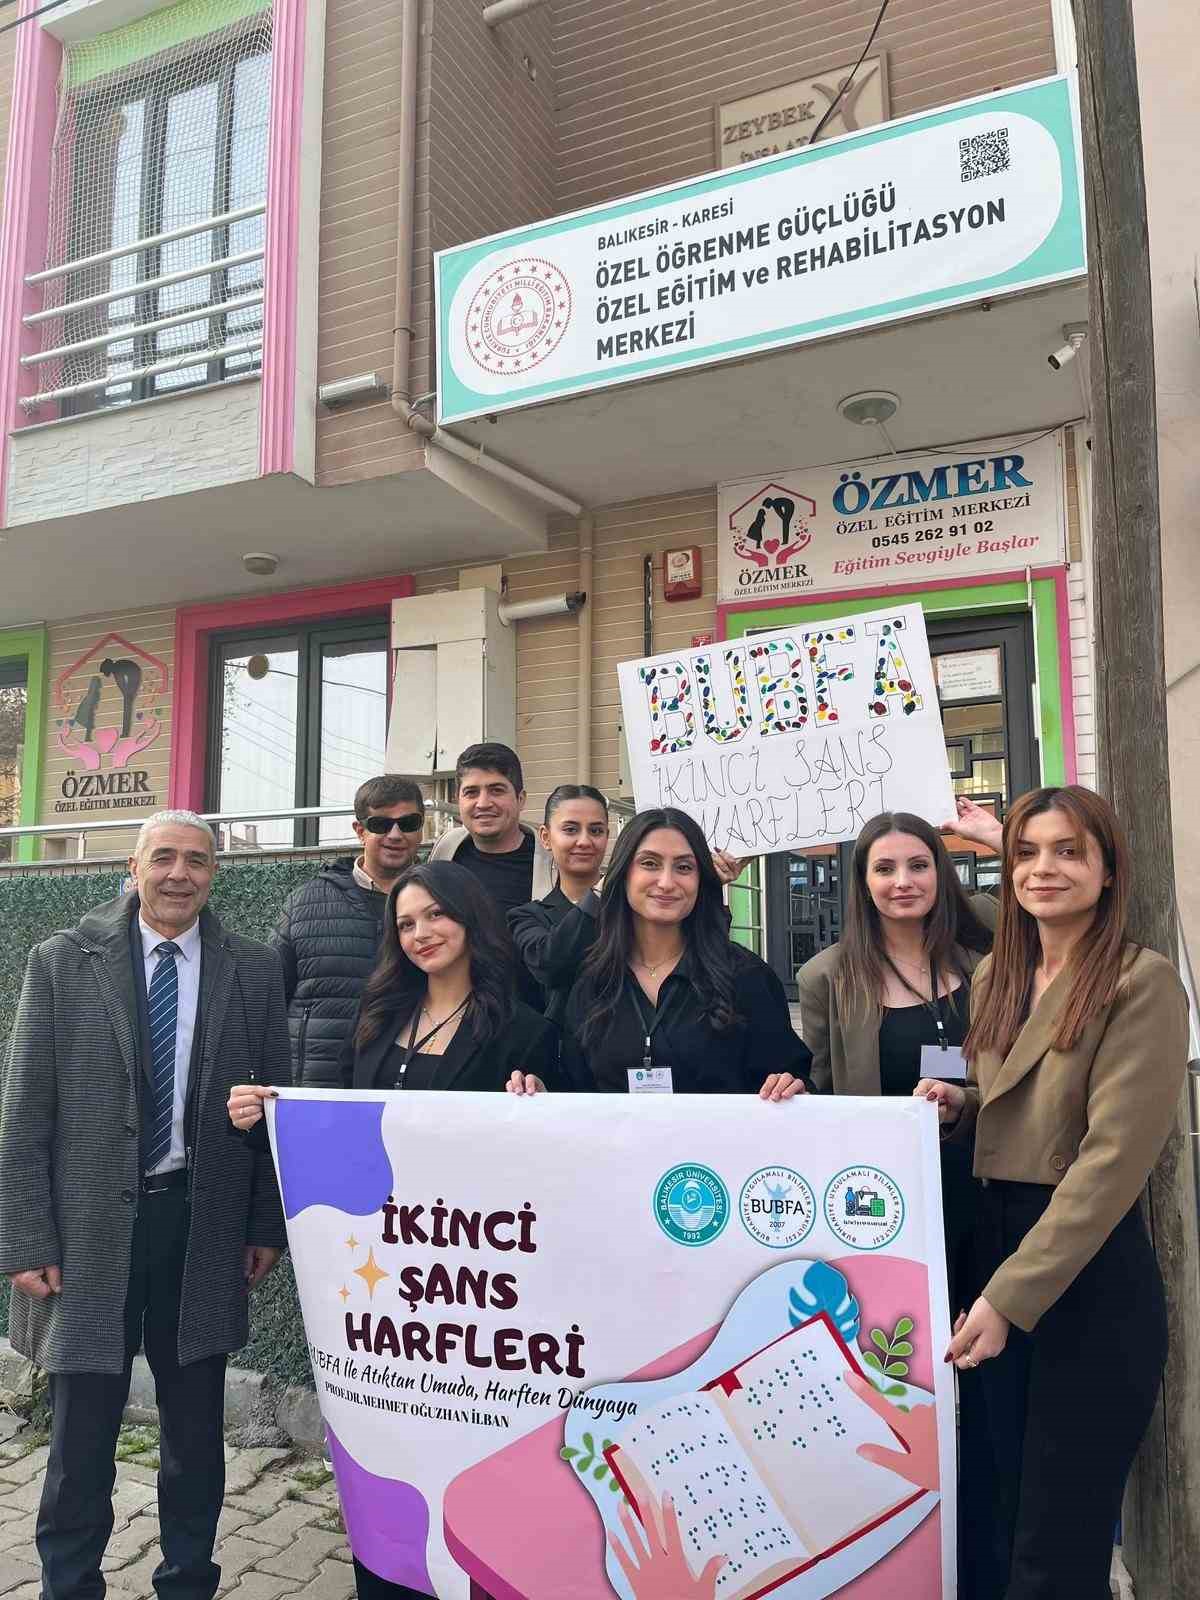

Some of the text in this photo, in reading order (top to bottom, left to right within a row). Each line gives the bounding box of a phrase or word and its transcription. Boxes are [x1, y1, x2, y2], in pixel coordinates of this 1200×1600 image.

[723, 100, 816, 145] ZEYBEK
[596, 181, 896, 288] ÖZEL ÖĞRENME GÜÇLÜĞÜ
[598, 218, 669, 250] BALIKESİR
[682, 197, 734, 228] KARESİ
[596, 198, 1006, 324] ÖZEL EĞİTİM ve REHABİLİTASYON
[597, 310, 695, 361] MERKEZİ
[832, 454, 1033, 516] ÖZMER
[836, 492, 1031, 536] ÖZEL EĞİTİM MERKEZİ
[872, 520, 994, 549] 0545 262 91 02
[738, 563, 809, 587] ÖZMER
[832, 535, 1039, 577] Eğitim Sevgiyle Başlar
[638, 615, 924, 756] BUBFA
[62, 770, 151, 799] ÖZMER
[381, 1195, 537, 1253] İKİNCİ
[750, 1199, 805, 1215] BUBFA
[769, 1220, 786, 1228] 2007
[398, 1263, 519, 1313] ŞANS
[345, 1312, 586, 1379] HARFLERİ
[344, 1356, 358, 1380] İle
[361, 1364, 416, 1391] Atıktan
[420, 1372, 479, 1401] Umuda,
[484, 1380, 552, 1409] Harften
[557, 1387, 638, 1423] Dünyaya
[410, 1402, 470, 1424] OĞUZHAN
[471, 1409, 510, 1428] İLBAN
